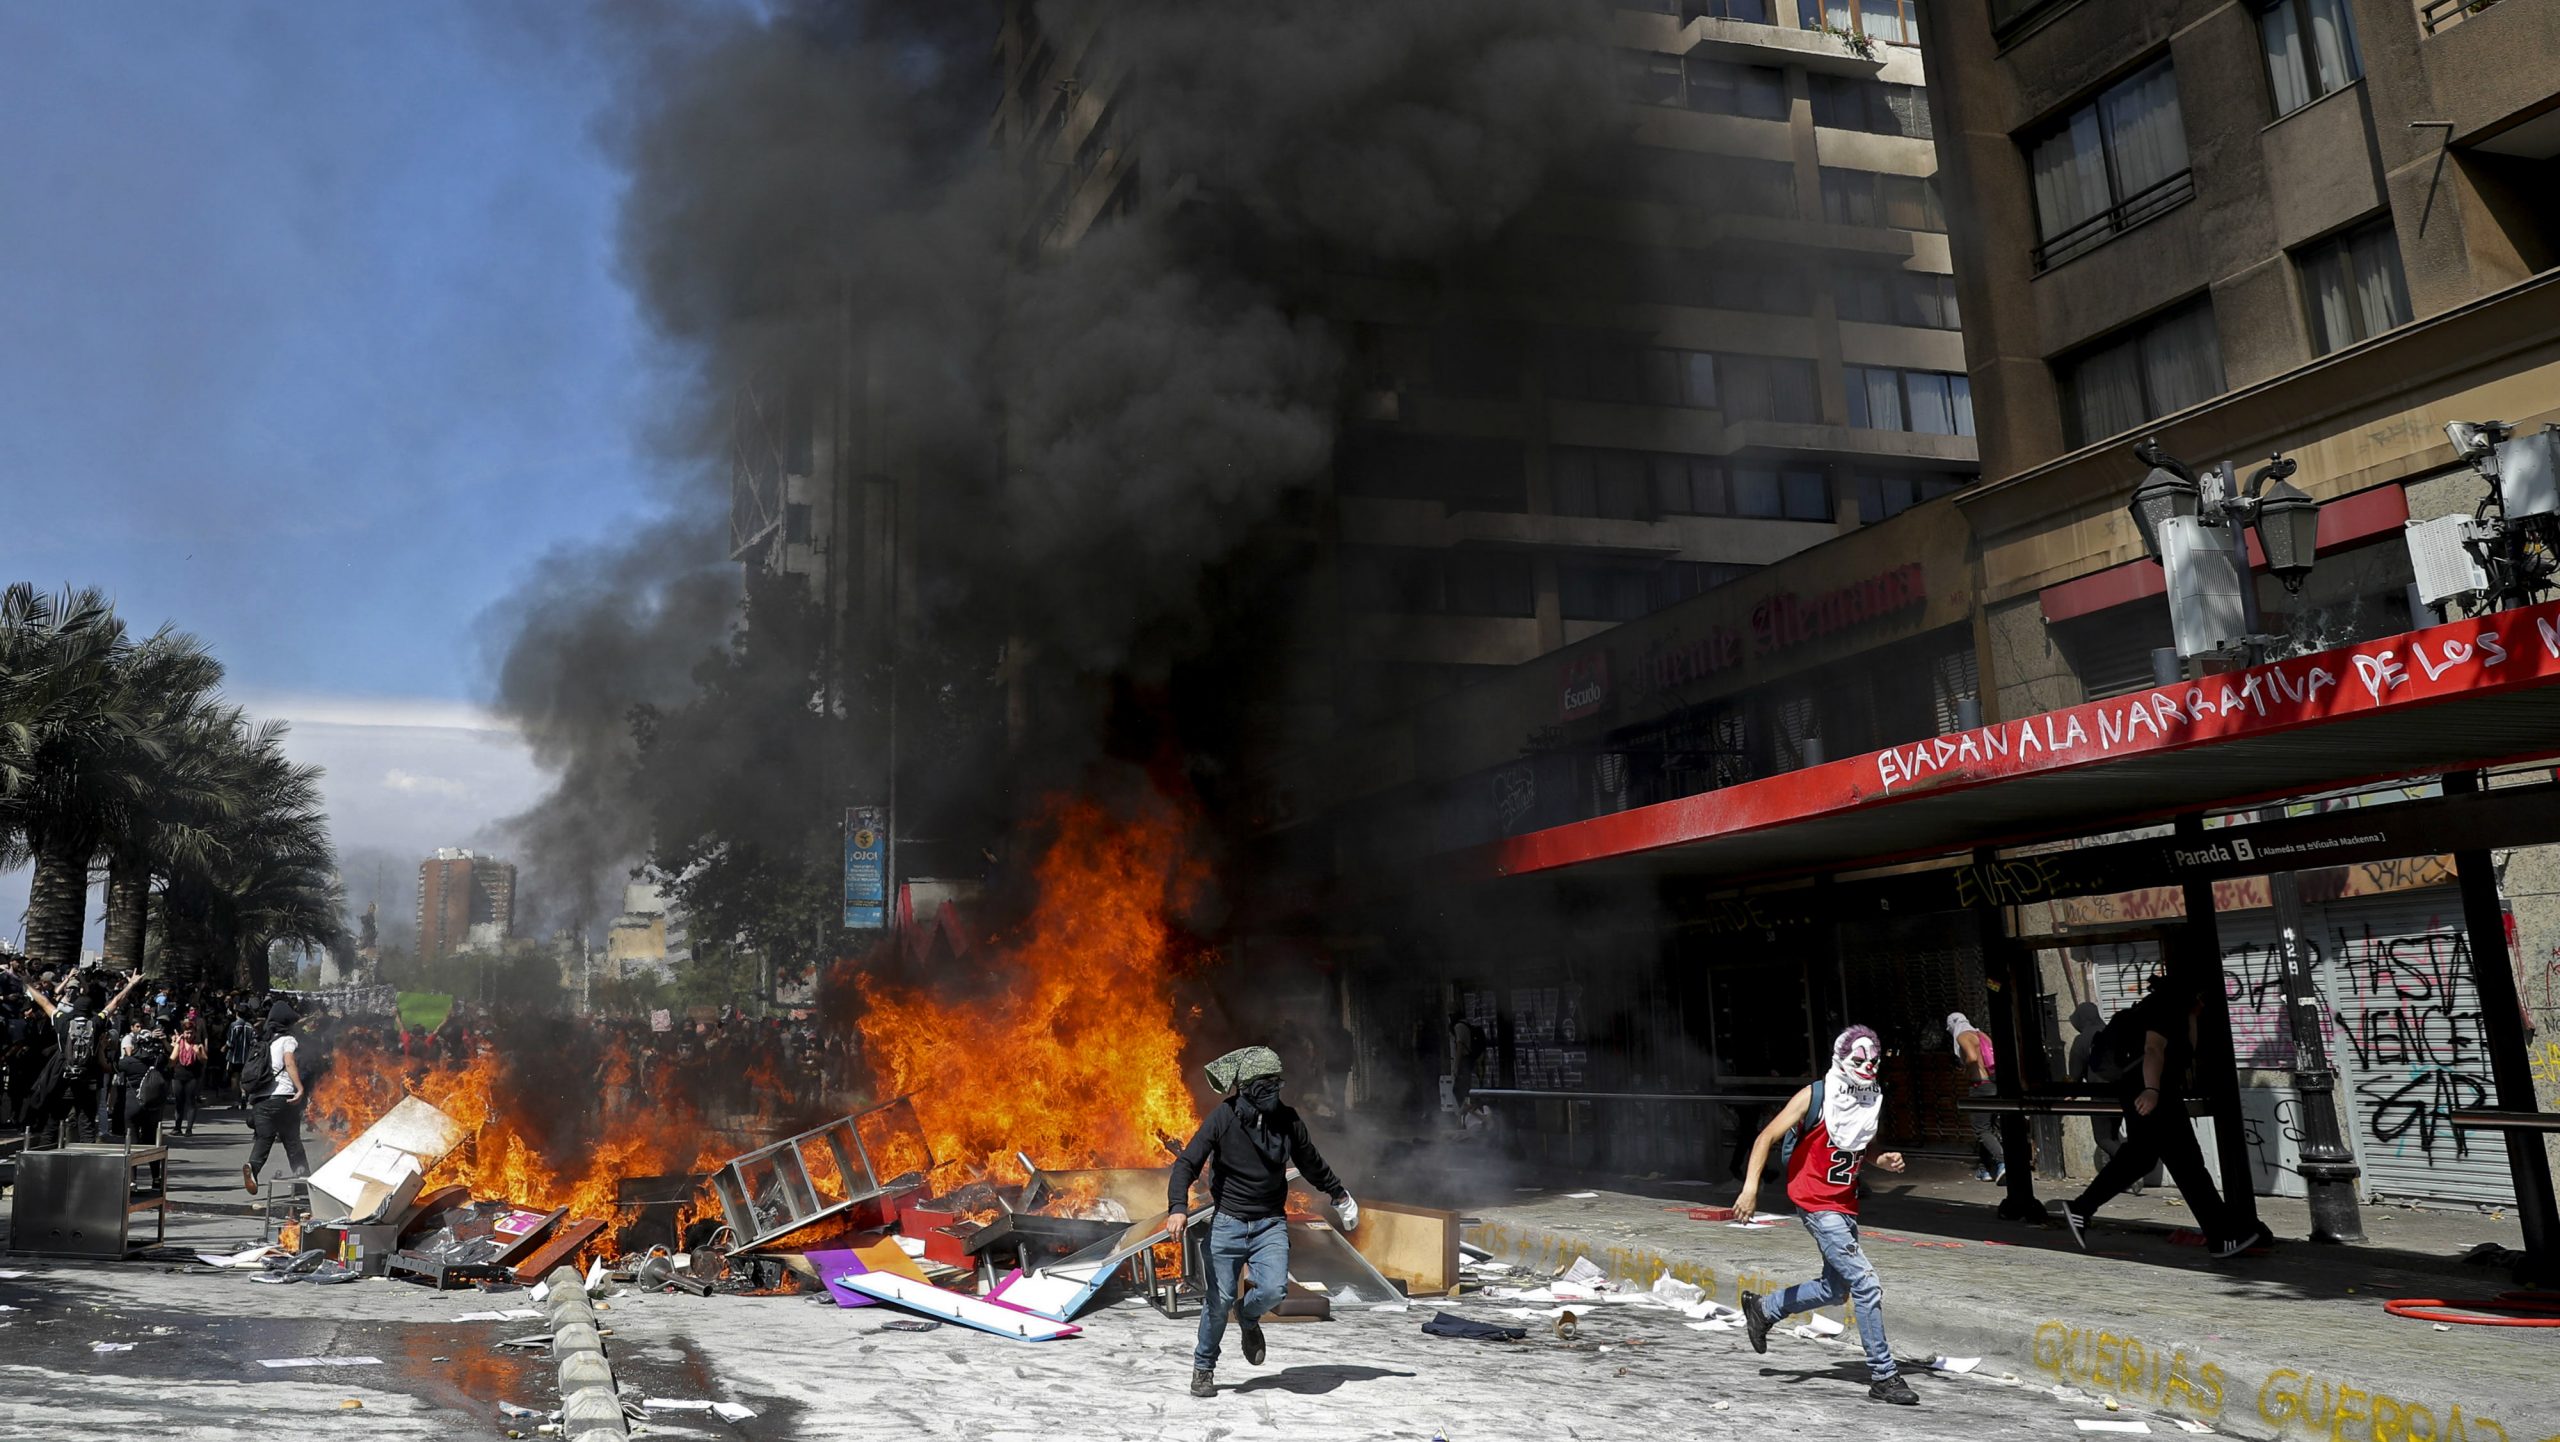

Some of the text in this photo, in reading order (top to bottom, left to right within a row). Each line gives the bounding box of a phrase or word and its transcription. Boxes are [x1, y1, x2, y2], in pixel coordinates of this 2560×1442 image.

[1751, 562, 1927, 658] Alemana
[1564, 682, 1601, 710] Escudo
[1877, 724, 2008, 795] EVADAN
[2097, 665, 2336, 750] NARRATIVA
[2352, 650, 2410, 704] DE
[2174, 844, 2232, 867] Parada
[2264, 845, 2295, 856] Alameda
[2313, 837, 2339, 849] Vicuña
[2340, 833, 2379, 846] Mackenna
[2338, 923, 2478, 1016] HASTA
[2032, 1319, 2225, 1418] QUERIAS
